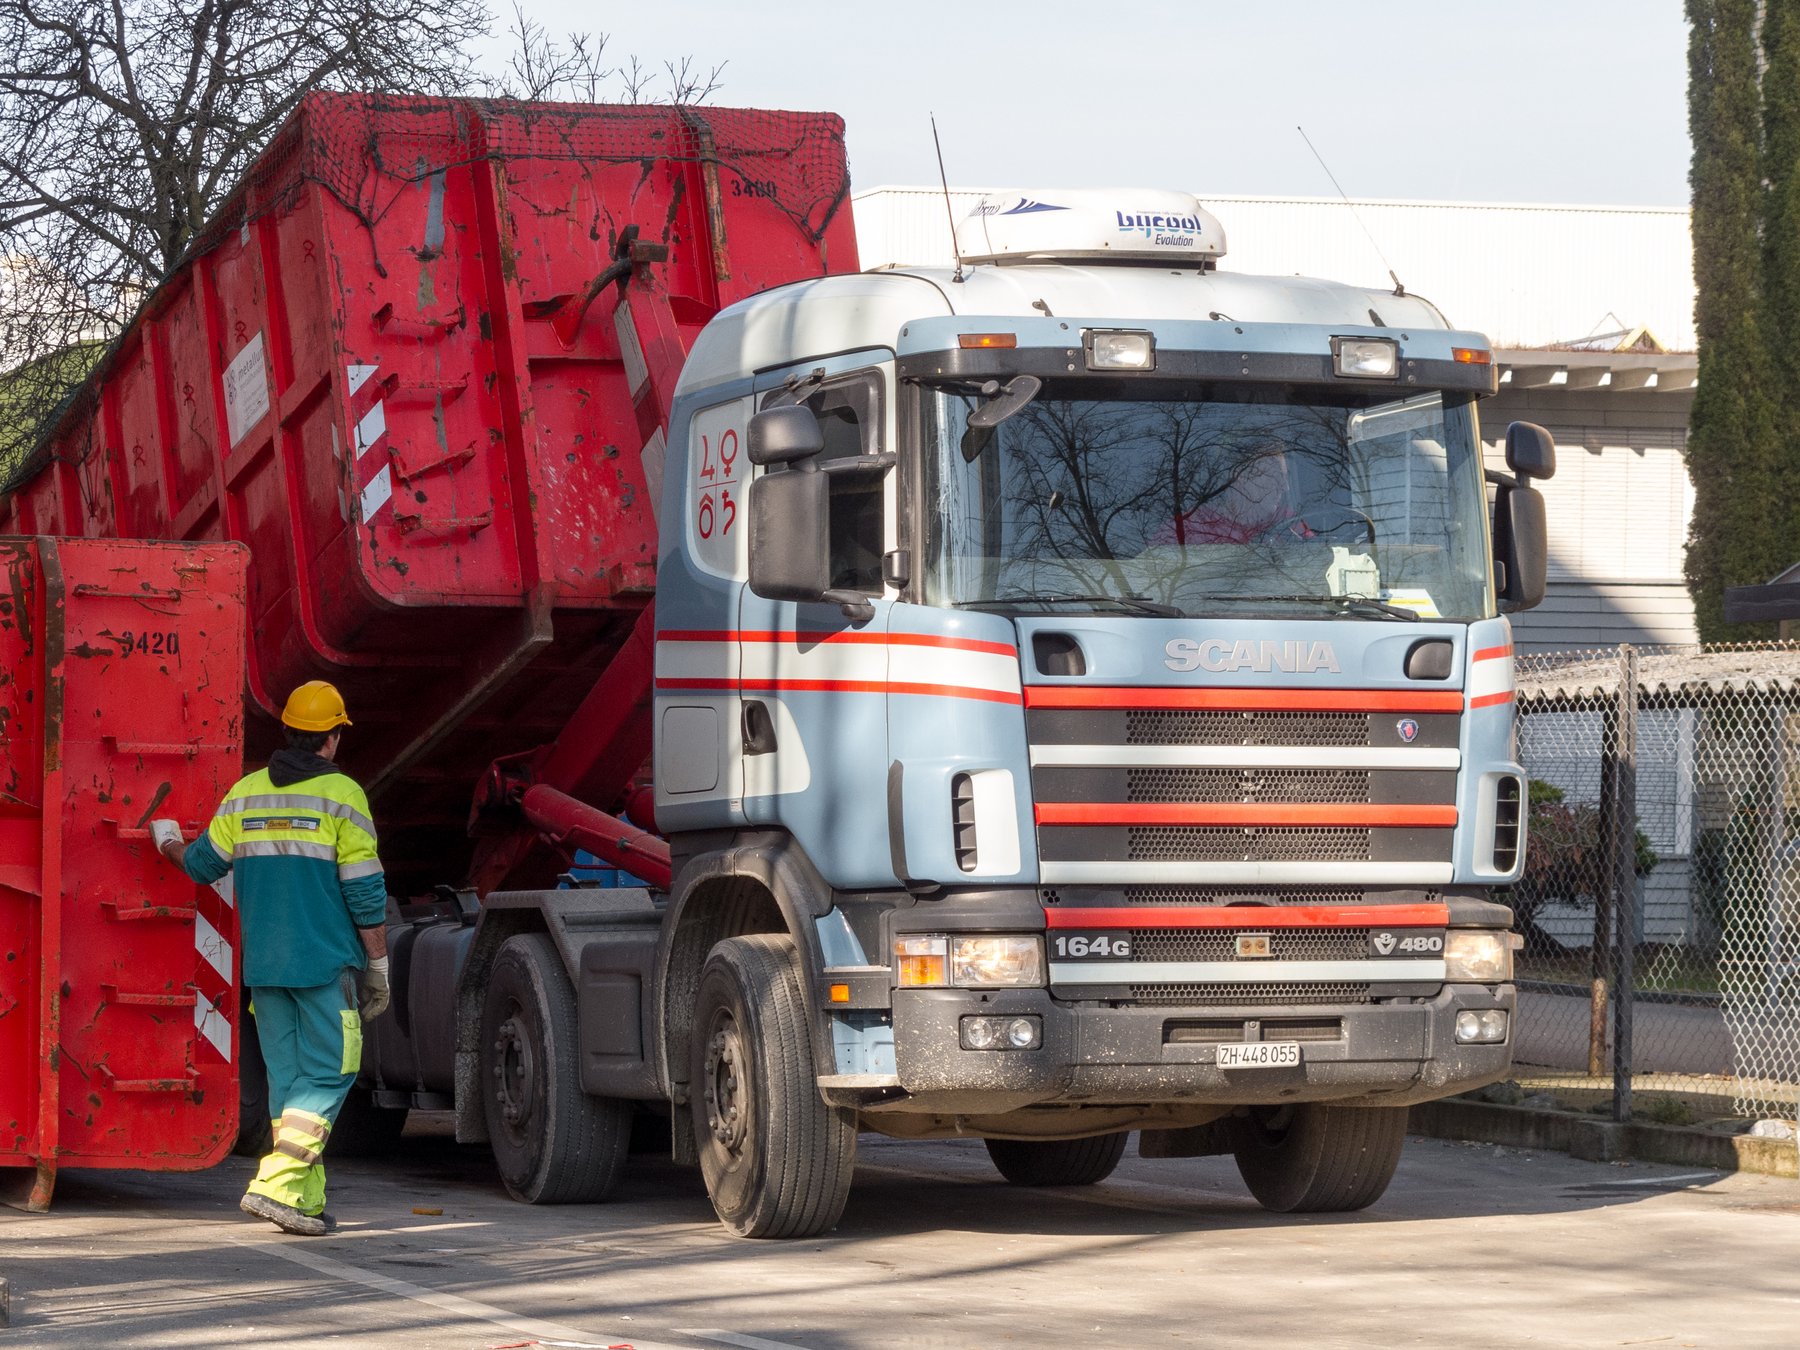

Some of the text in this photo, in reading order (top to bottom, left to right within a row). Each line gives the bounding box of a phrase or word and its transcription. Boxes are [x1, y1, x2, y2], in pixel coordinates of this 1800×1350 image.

[1116, 210, 1202, 238] bycool
[1155, 233, 1194, 247] Evolution
[1164, 638, 1342, 673] SCANIA
[1055, 936, 1130, 957] 164G
[1400, 936, 1443, 951] 480
